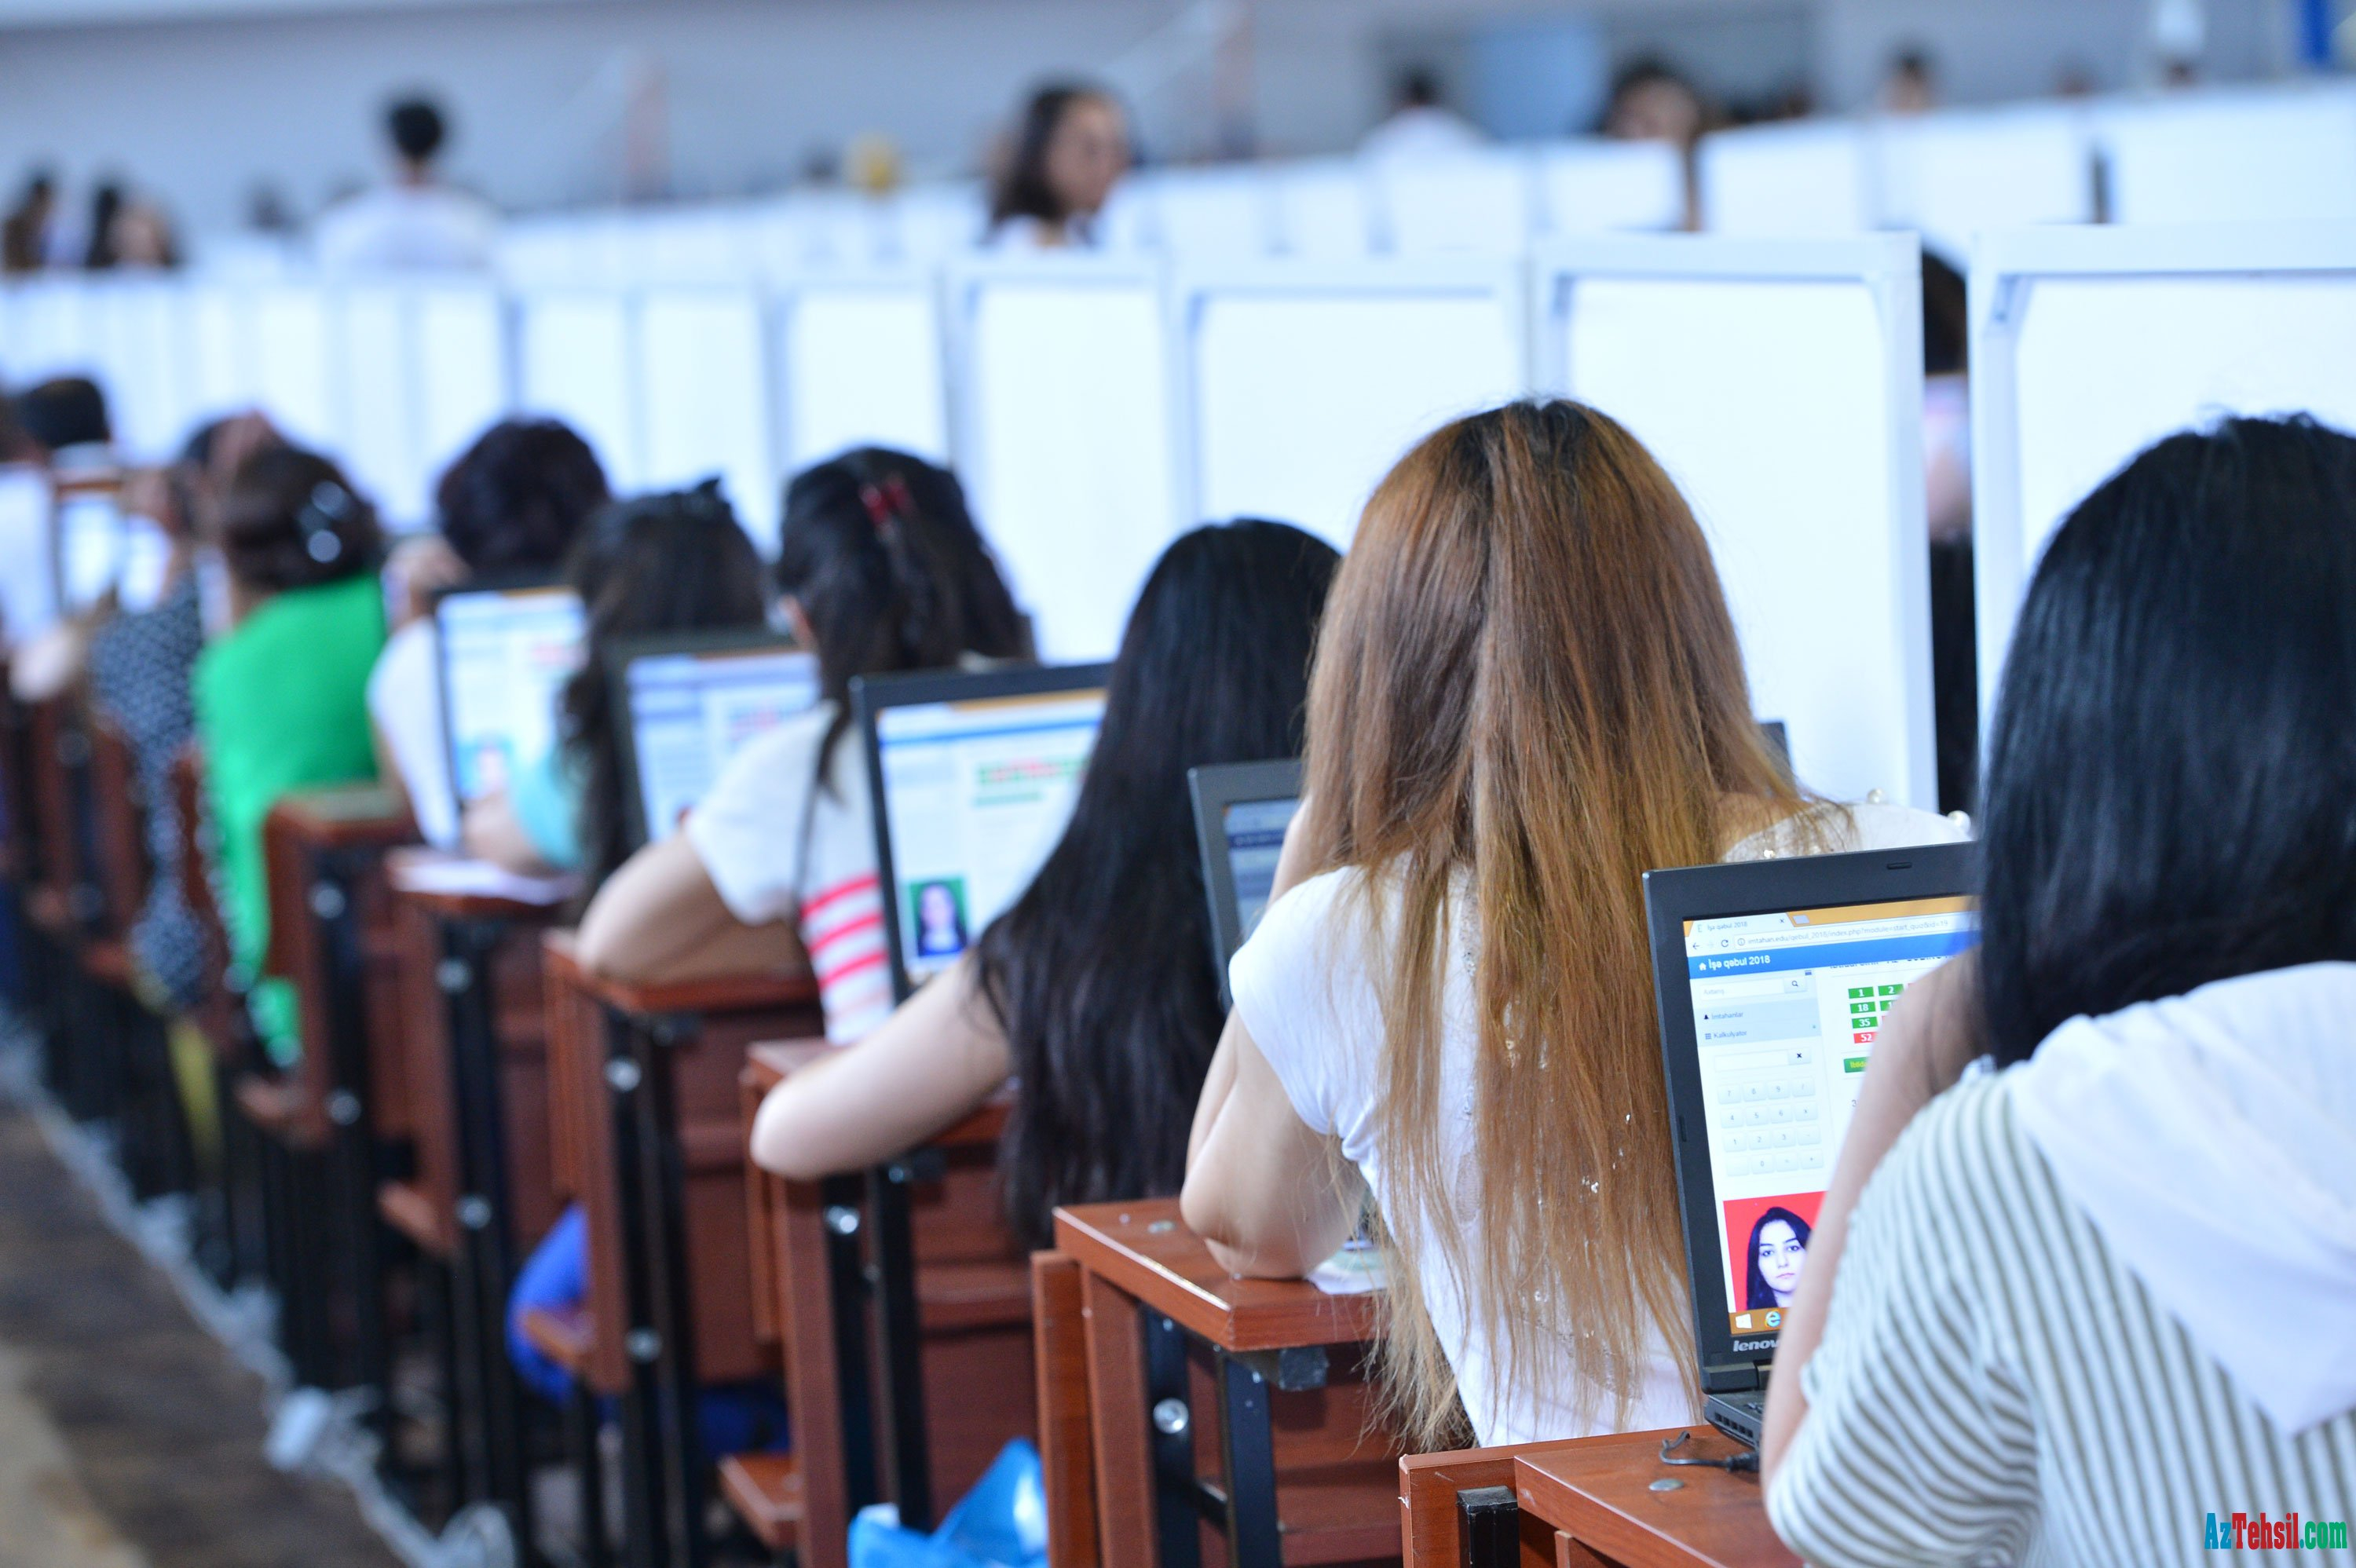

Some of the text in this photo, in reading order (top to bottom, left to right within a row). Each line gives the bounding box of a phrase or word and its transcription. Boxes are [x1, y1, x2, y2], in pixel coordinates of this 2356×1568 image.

[1749, 955, 1771, 965] 2018
[1858, 989, 1865, 997] 1
[1857, 1003, 1869, 1012] 18
[1858, 1018, 1871, 1027] 35
[1714, 1029, 1747, 1040] Kalkulyator
[1860, 1033, 1873, 1042] 52
[1732, 1339, 1780, 1352] lenov
